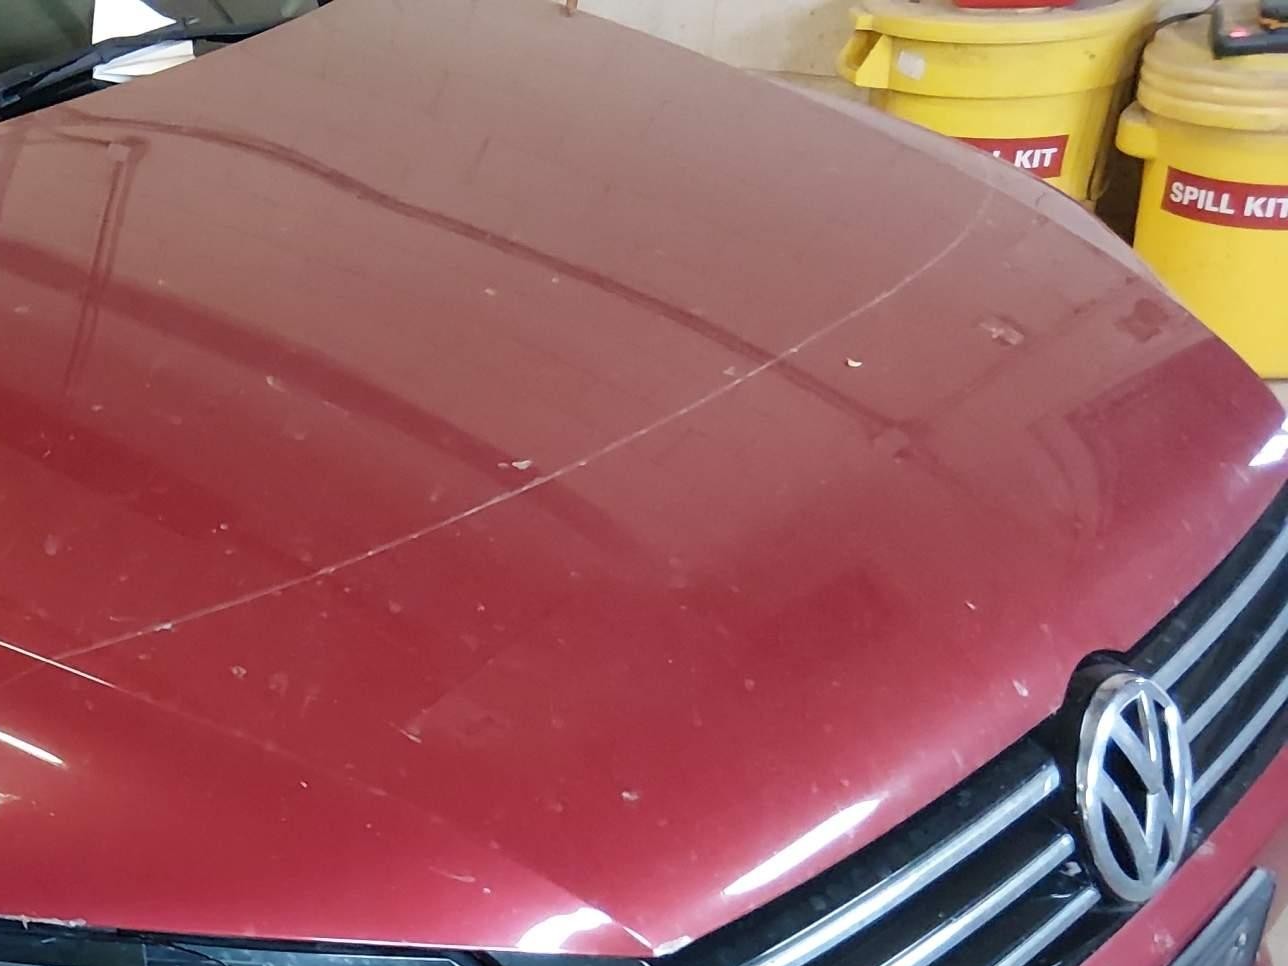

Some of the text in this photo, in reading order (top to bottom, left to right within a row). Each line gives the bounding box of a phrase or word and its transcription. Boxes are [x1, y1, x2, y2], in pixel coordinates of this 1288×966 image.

[1014, 147, 1058, 169] KIT
[1169, 181, 1288, 219] SPILL KIT
